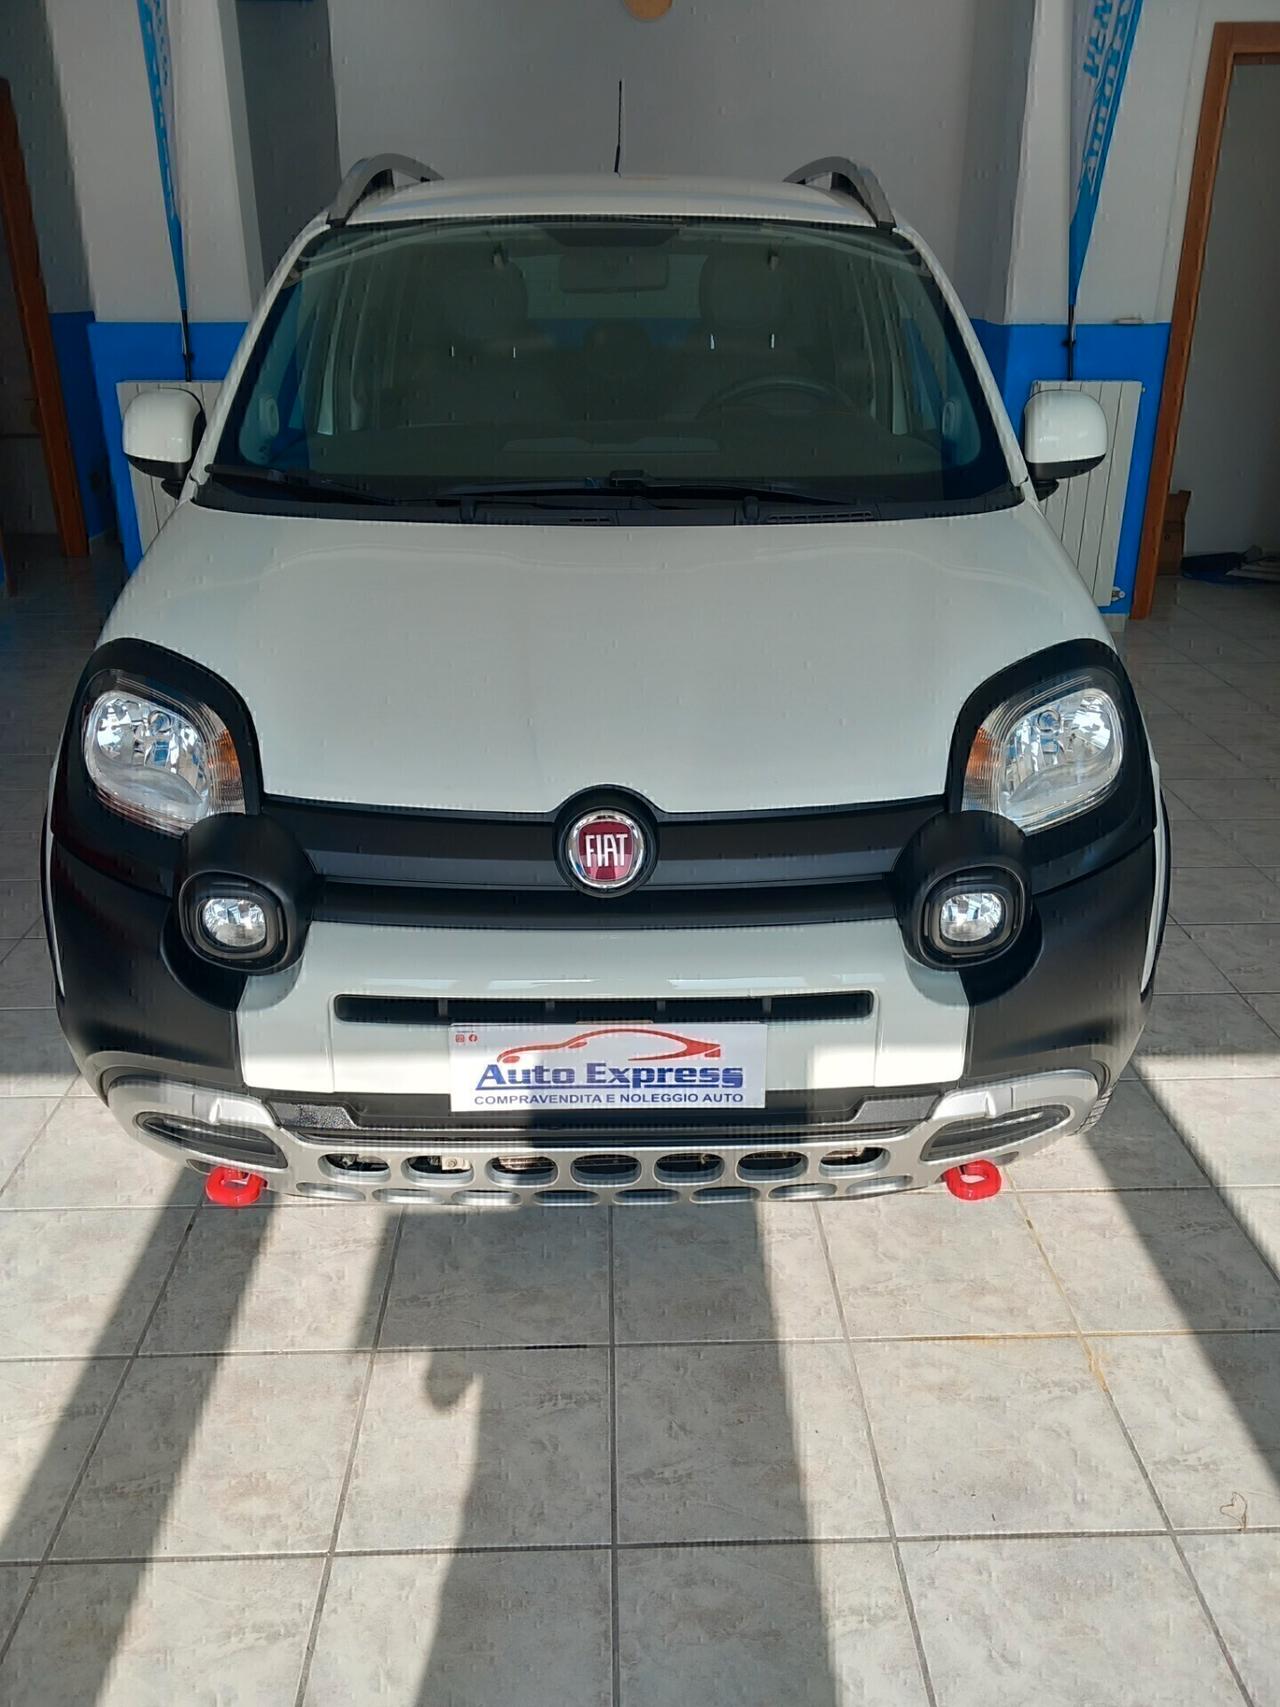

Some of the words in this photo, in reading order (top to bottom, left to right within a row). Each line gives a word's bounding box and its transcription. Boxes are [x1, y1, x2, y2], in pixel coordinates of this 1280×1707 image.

[585, 834, 628, 868] FIAT
[475, 1064, 575, 1091] Auto
[586, 1063, 744, 1089] Express
[474, 1094, 602, 1105] COMPRAVENDITA
[606, 1094, 616, 1103] E
[620, 1093, 699, 1103] NOLEGGIO
[702, 1093, 744, 1103] AUTO
